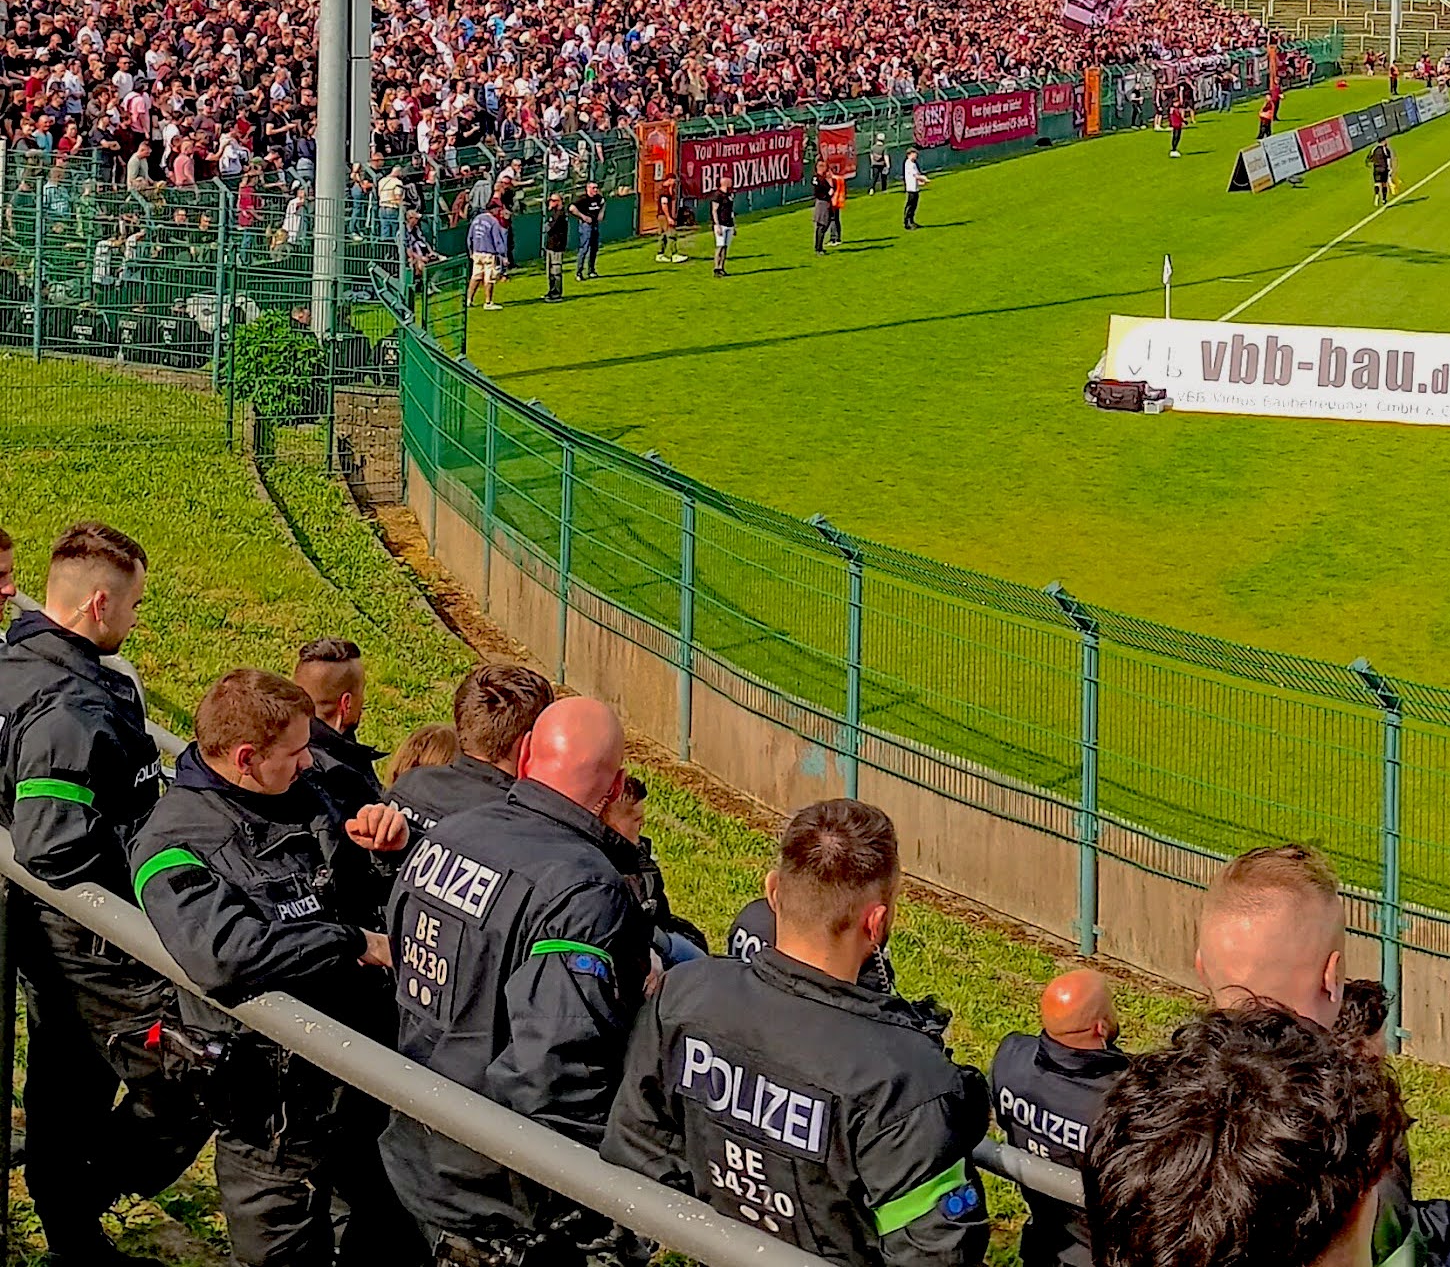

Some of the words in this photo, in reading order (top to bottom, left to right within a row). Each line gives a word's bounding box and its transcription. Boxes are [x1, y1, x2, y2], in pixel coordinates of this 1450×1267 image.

[722, 142, 745, 157] never
[701, 163, 728, 194] BFC
[732, 153, 790, 190] DYNAMO
[403, 838, 502, 920] POLIZEI
[276, 893, 322, 922] POLIZEI
[414, 910, 443, 949] BE
[402, 935, 448, 986] 34230
[681, 1035, 826, 1153] POLIZEI
[999, 1086, 1089, 1154] POLIZEI
[724, 1138, 766, 1181] BE
[707, 1159, 796, 1218] 34220
